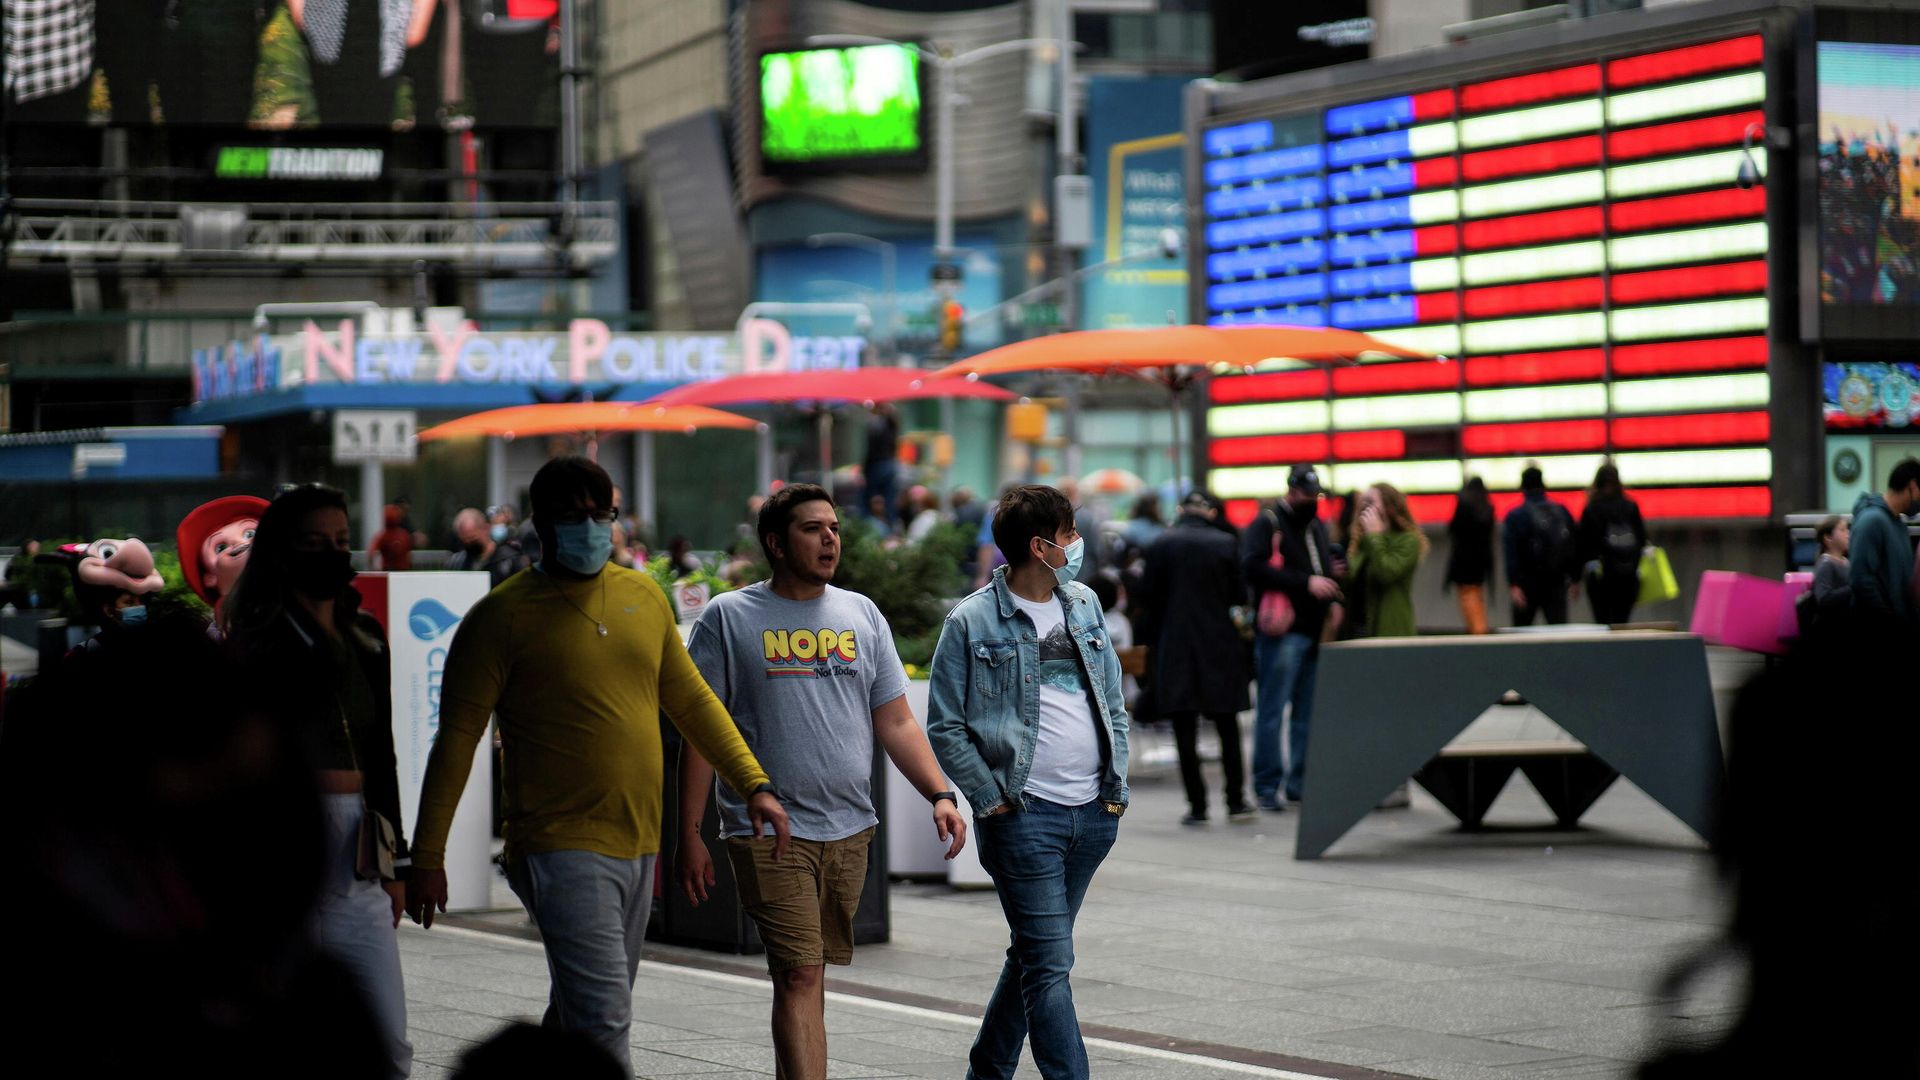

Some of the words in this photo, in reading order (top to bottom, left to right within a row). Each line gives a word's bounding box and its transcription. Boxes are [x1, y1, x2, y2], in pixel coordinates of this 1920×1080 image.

[303, 318, 422, 384] NEW
[425, 319, 557, 384] YORK
[568, 318, 728, 384] POLICE
[762, 628, 857, 666] NOPE
[814, 667, 833, 679] Not
[832, 665, 858, 678] Today
